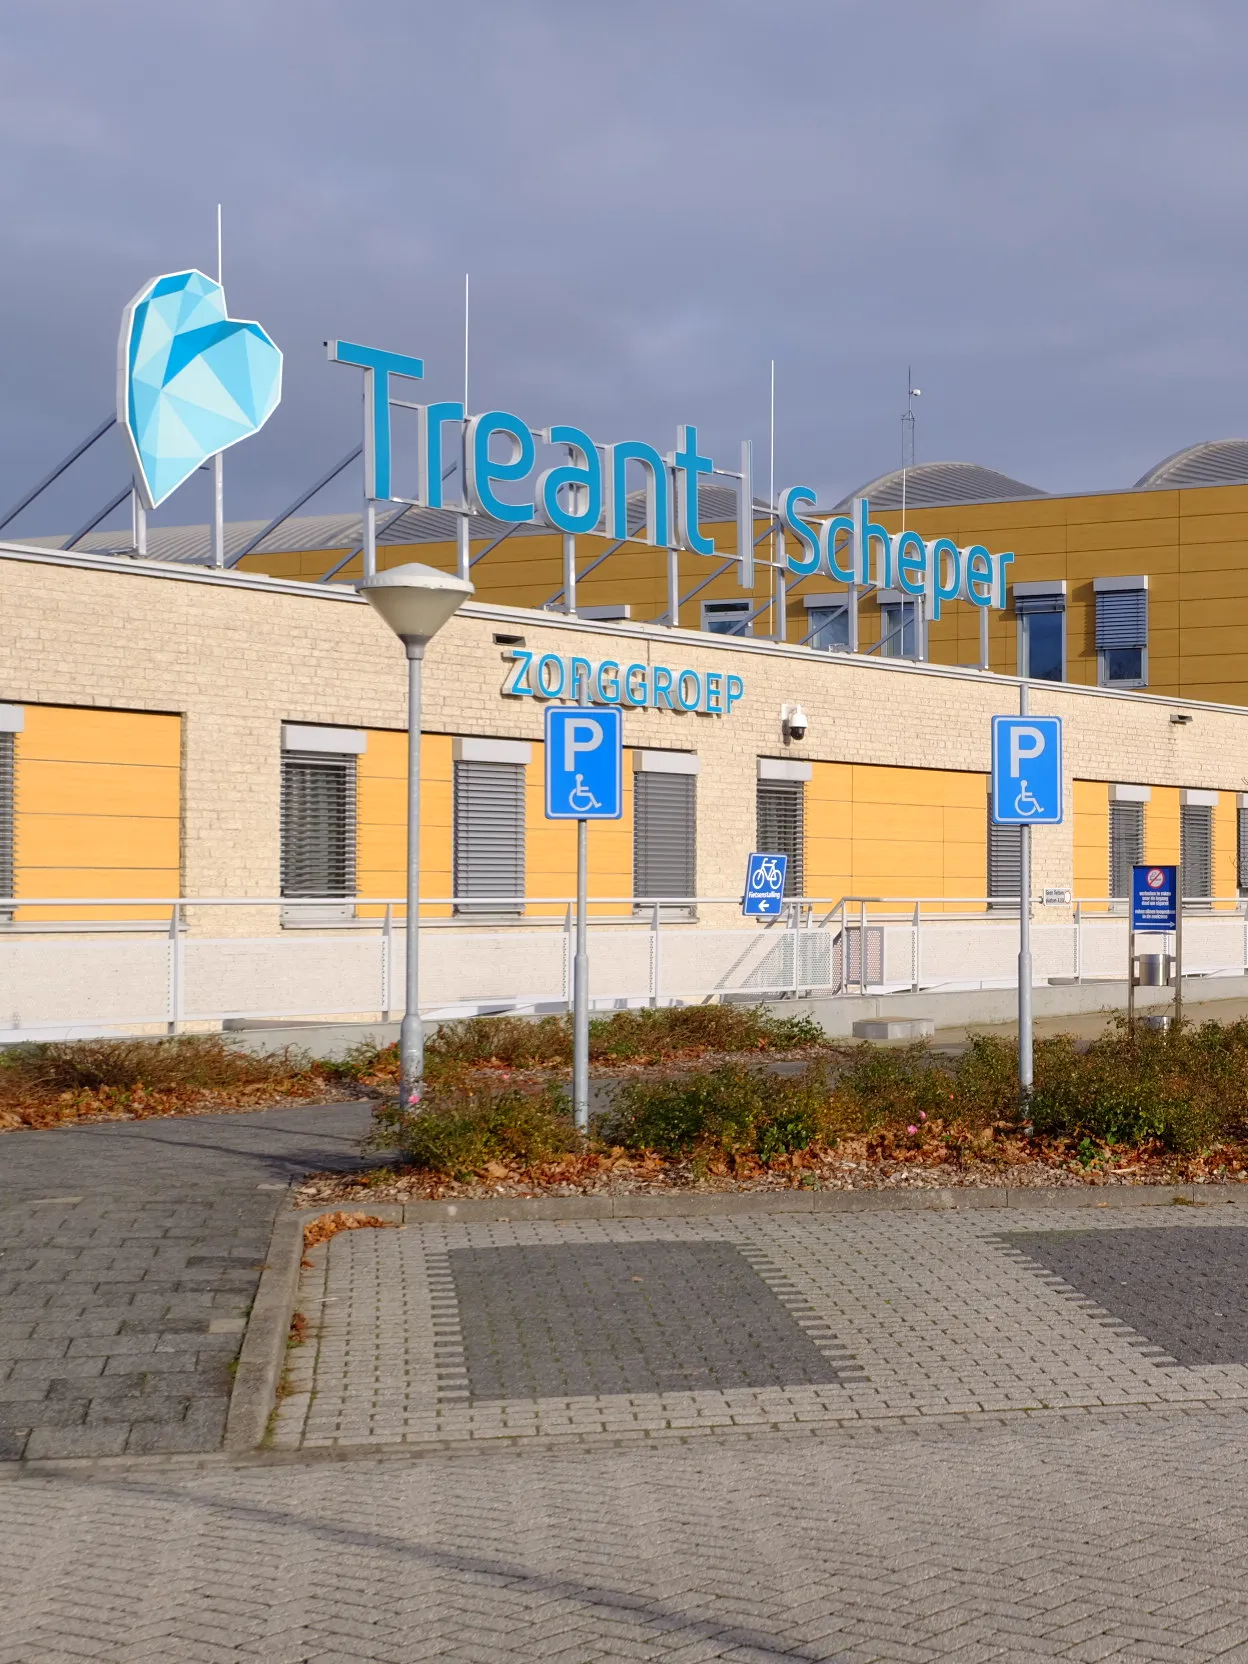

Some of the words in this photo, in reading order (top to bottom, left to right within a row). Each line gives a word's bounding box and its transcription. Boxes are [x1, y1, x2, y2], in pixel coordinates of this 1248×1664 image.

[328, 339, 715, 556] Treant
[779, 485, 1014, 621] Scheper
[503, 650, 744, 714] ZORGGROEP
[564, 718, 603, 771] P
[1010, 726, 1045, 778] P
[748, 891, 780, 899] Fietsenstalling
